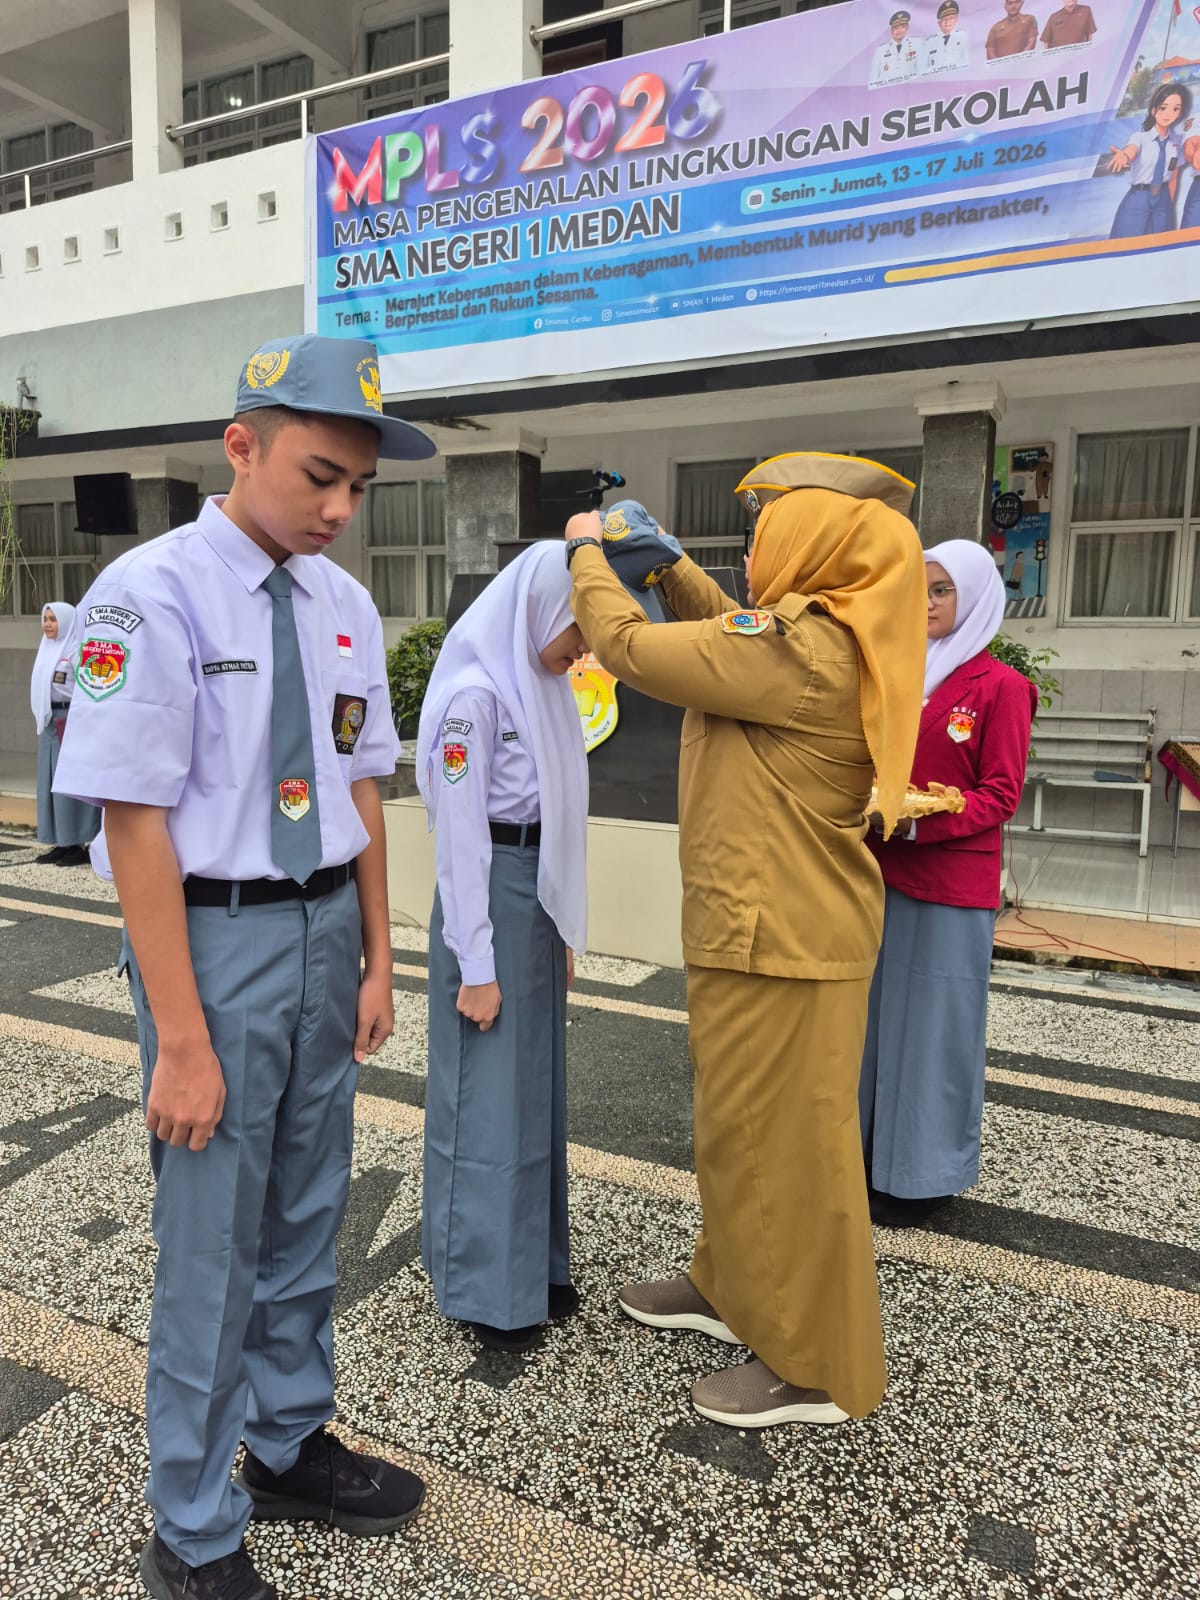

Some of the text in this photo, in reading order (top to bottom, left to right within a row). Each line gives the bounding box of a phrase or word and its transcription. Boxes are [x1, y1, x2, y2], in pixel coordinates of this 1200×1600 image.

[333, 59, 717, 213] MPLS 2026
[333, 71, 1089, 248] MASA PENGENALAN LINGKUNGAN SEKOLAH
[770, 183, 816, 204] Senin
[829, 172, 888, 195] Jumat,
[891, 164, 911, 183] 13
[925, 157, 947, 178] 17
[952, 151, 985, 174] Juli
[991, 141, 1048, 166] 2026
[334, 249, 402, 290] SMA
[405, 229, 520, 280] NEGERI
[527, 219, 543, 258] 1
[546, 192, 682, 256] MEDAN
[384, 195, 1050, 315] Merajut Kebersamaan dalam Keberagaman, Membentuk Murid yang Berkarakter,
[335, 309, 373, 329] Tema
[384, 285, 599, 329] Berprestasi dan Rukun Sesama.
[99, 615, 126, 626] MEDAN
[110, 608, 131, 620] NEGERI
